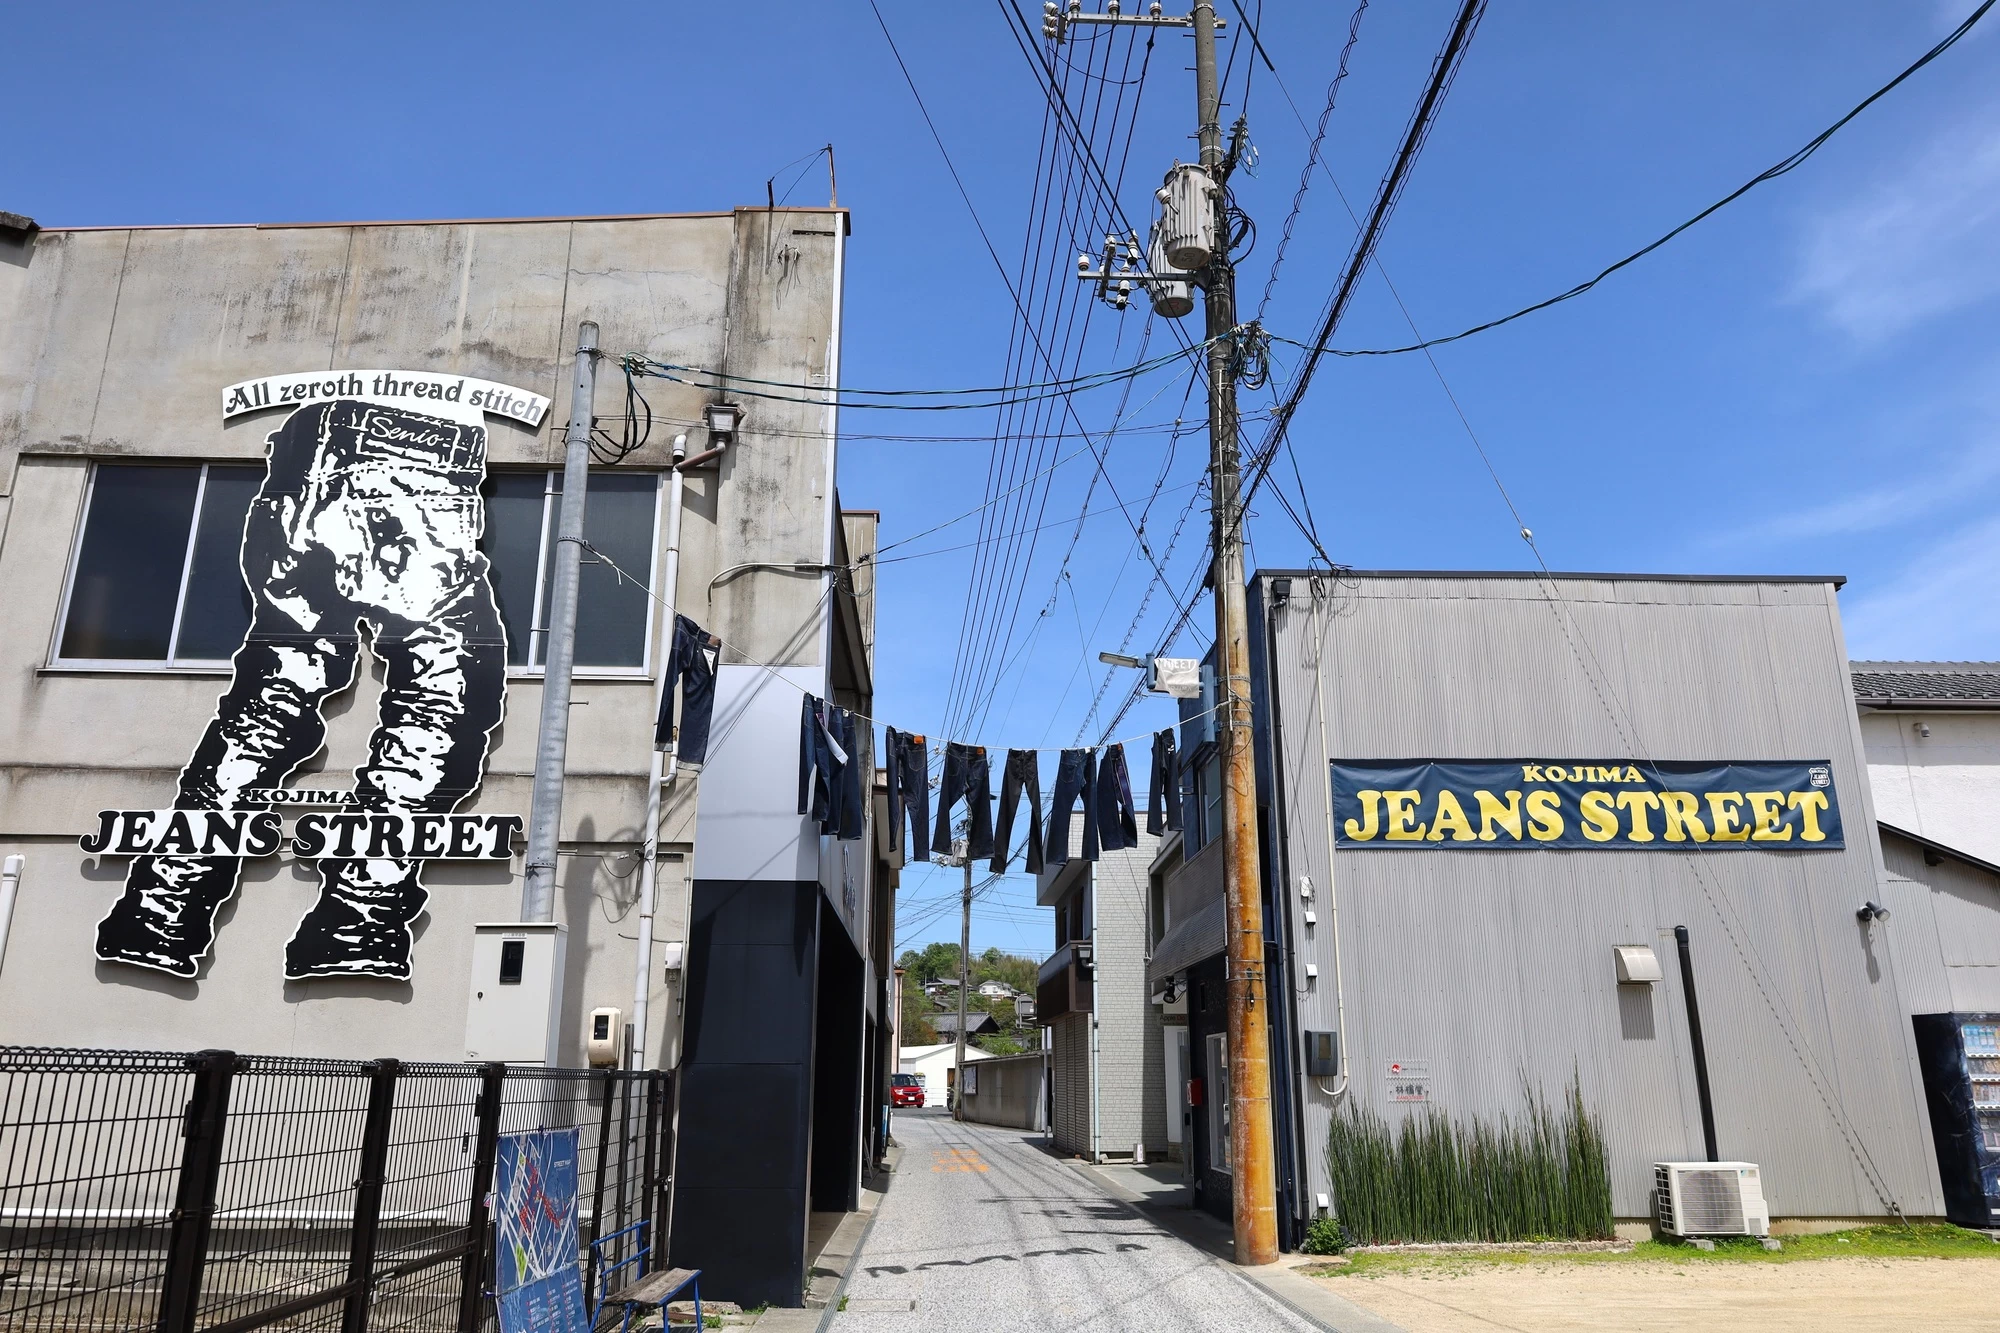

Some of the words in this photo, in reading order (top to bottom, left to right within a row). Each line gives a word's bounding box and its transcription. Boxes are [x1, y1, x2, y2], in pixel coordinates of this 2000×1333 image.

[225, 381, 271, 415] All
[280, 372, 364, 401] zeroth
[373, 373, 465, 403] thread
[469, 388, 542, 423] stitch
[250, 789, 360, 805] KOJIMA
[1521, 764, 1646, 784] KOJIMA
[80, 810, 284, 855] JEANS
[293, 814, 522, 859] STREET
[1343, 789, 1564, 842] JEANS
[1579, 790, 1830, 843] STREET
